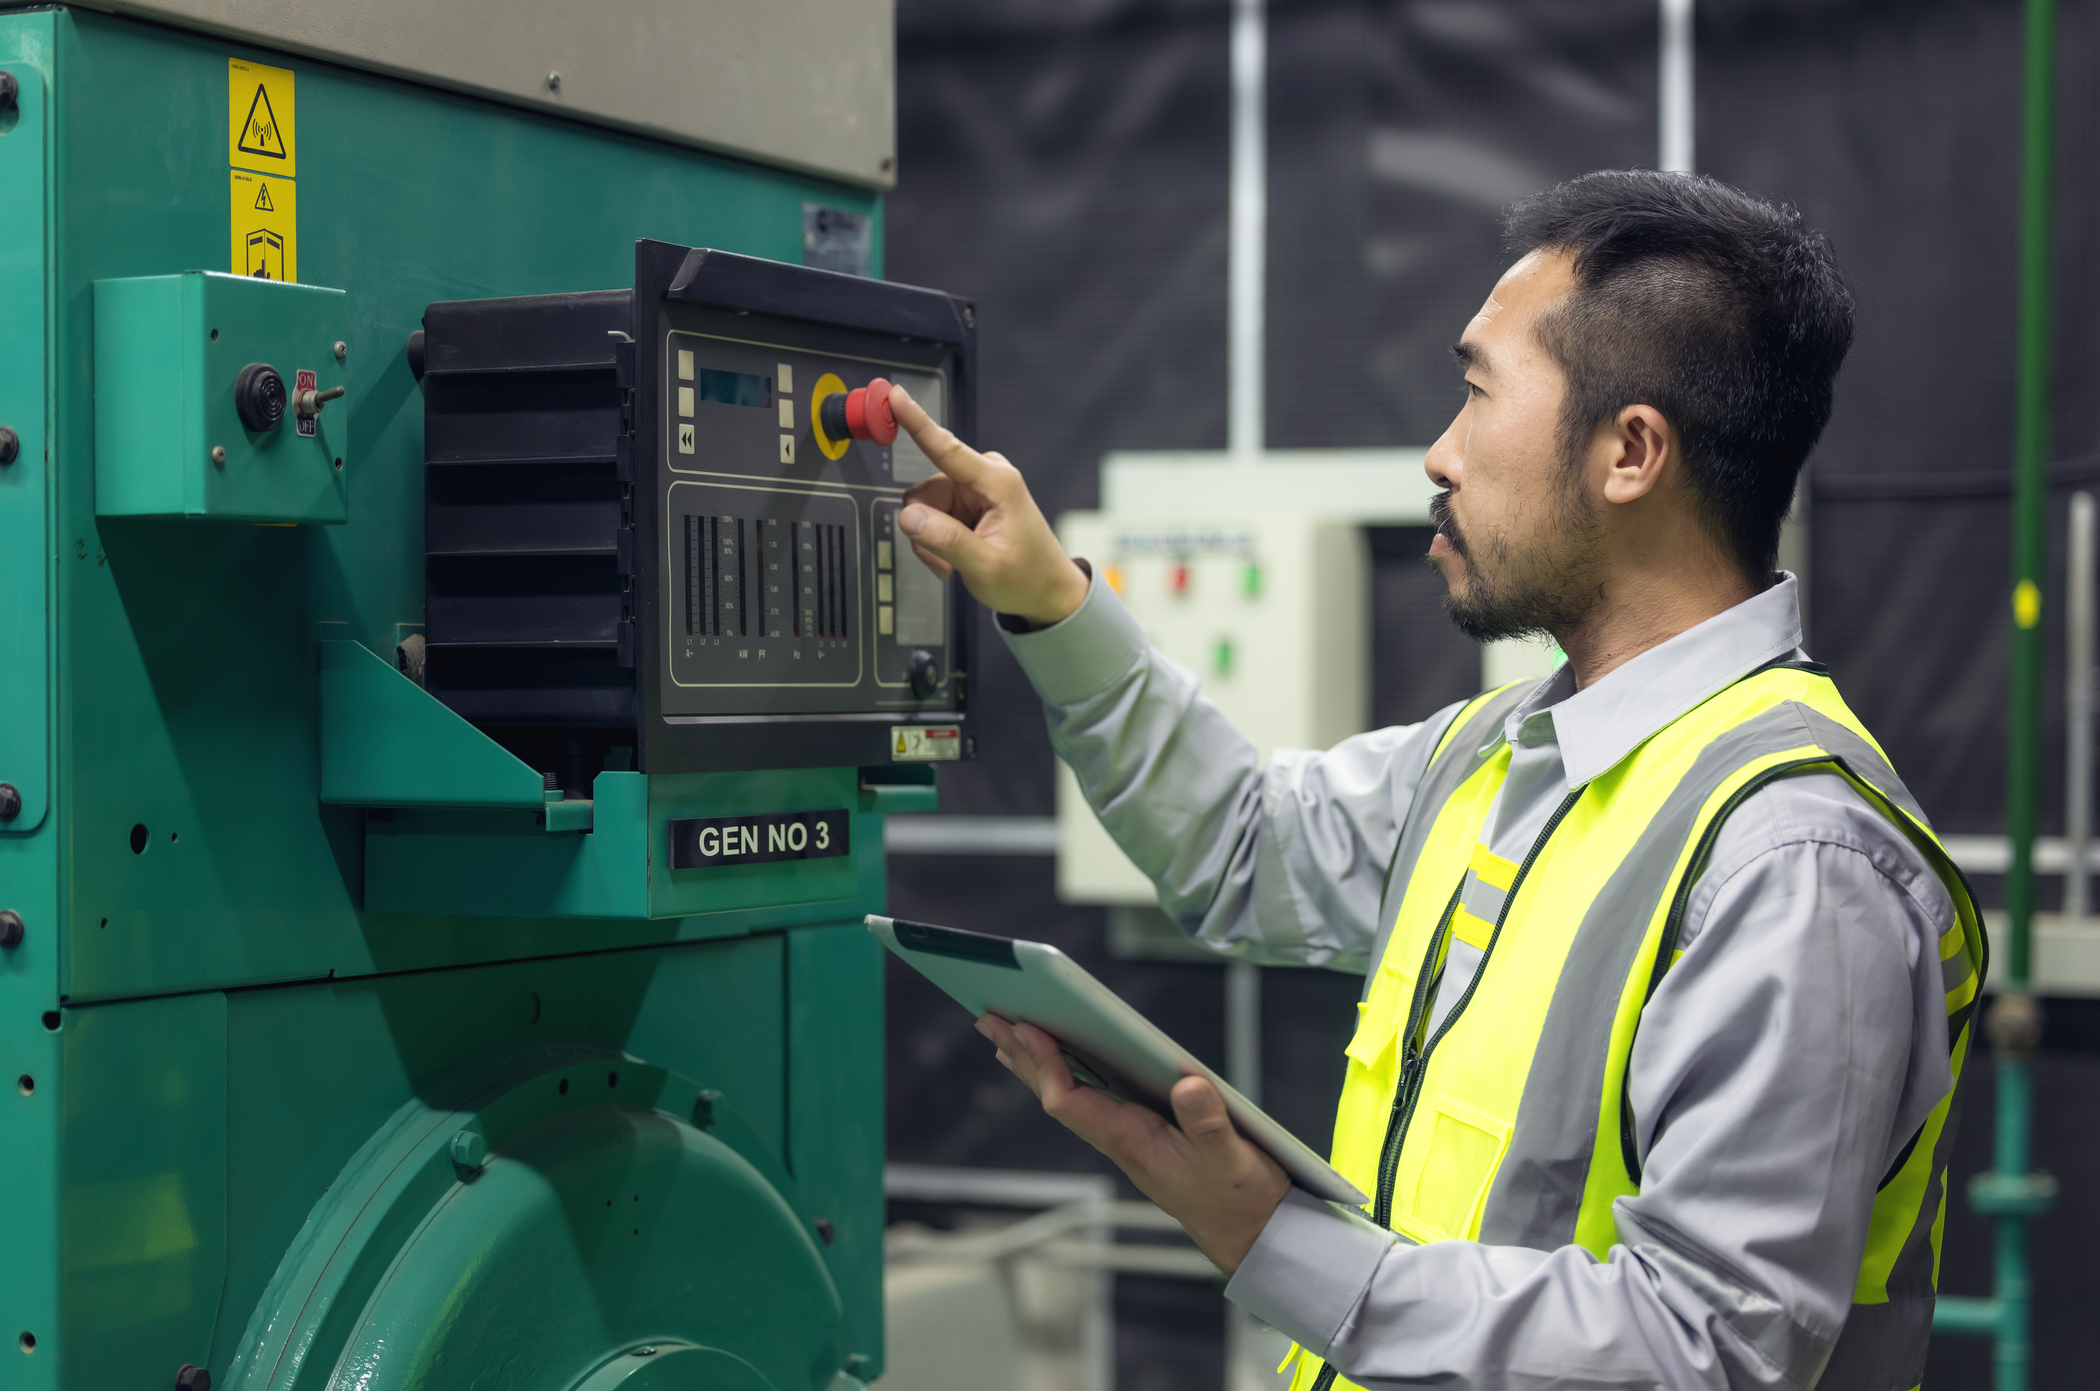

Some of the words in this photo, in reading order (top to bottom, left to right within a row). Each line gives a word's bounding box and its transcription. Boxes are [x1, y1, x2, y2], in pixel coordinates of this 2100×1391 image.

[299, 374, 313, 387] ON
[299, 420, 313, 432] OFF
[739, 650, 748, 658] kW
[759, 650, 766, 658] PF
[793, 650, 800, 659] Hz
[699, 826, 759, 857] GEN
[768, 822, 808, 852] NO
[815, 821, 830, 850] 3
